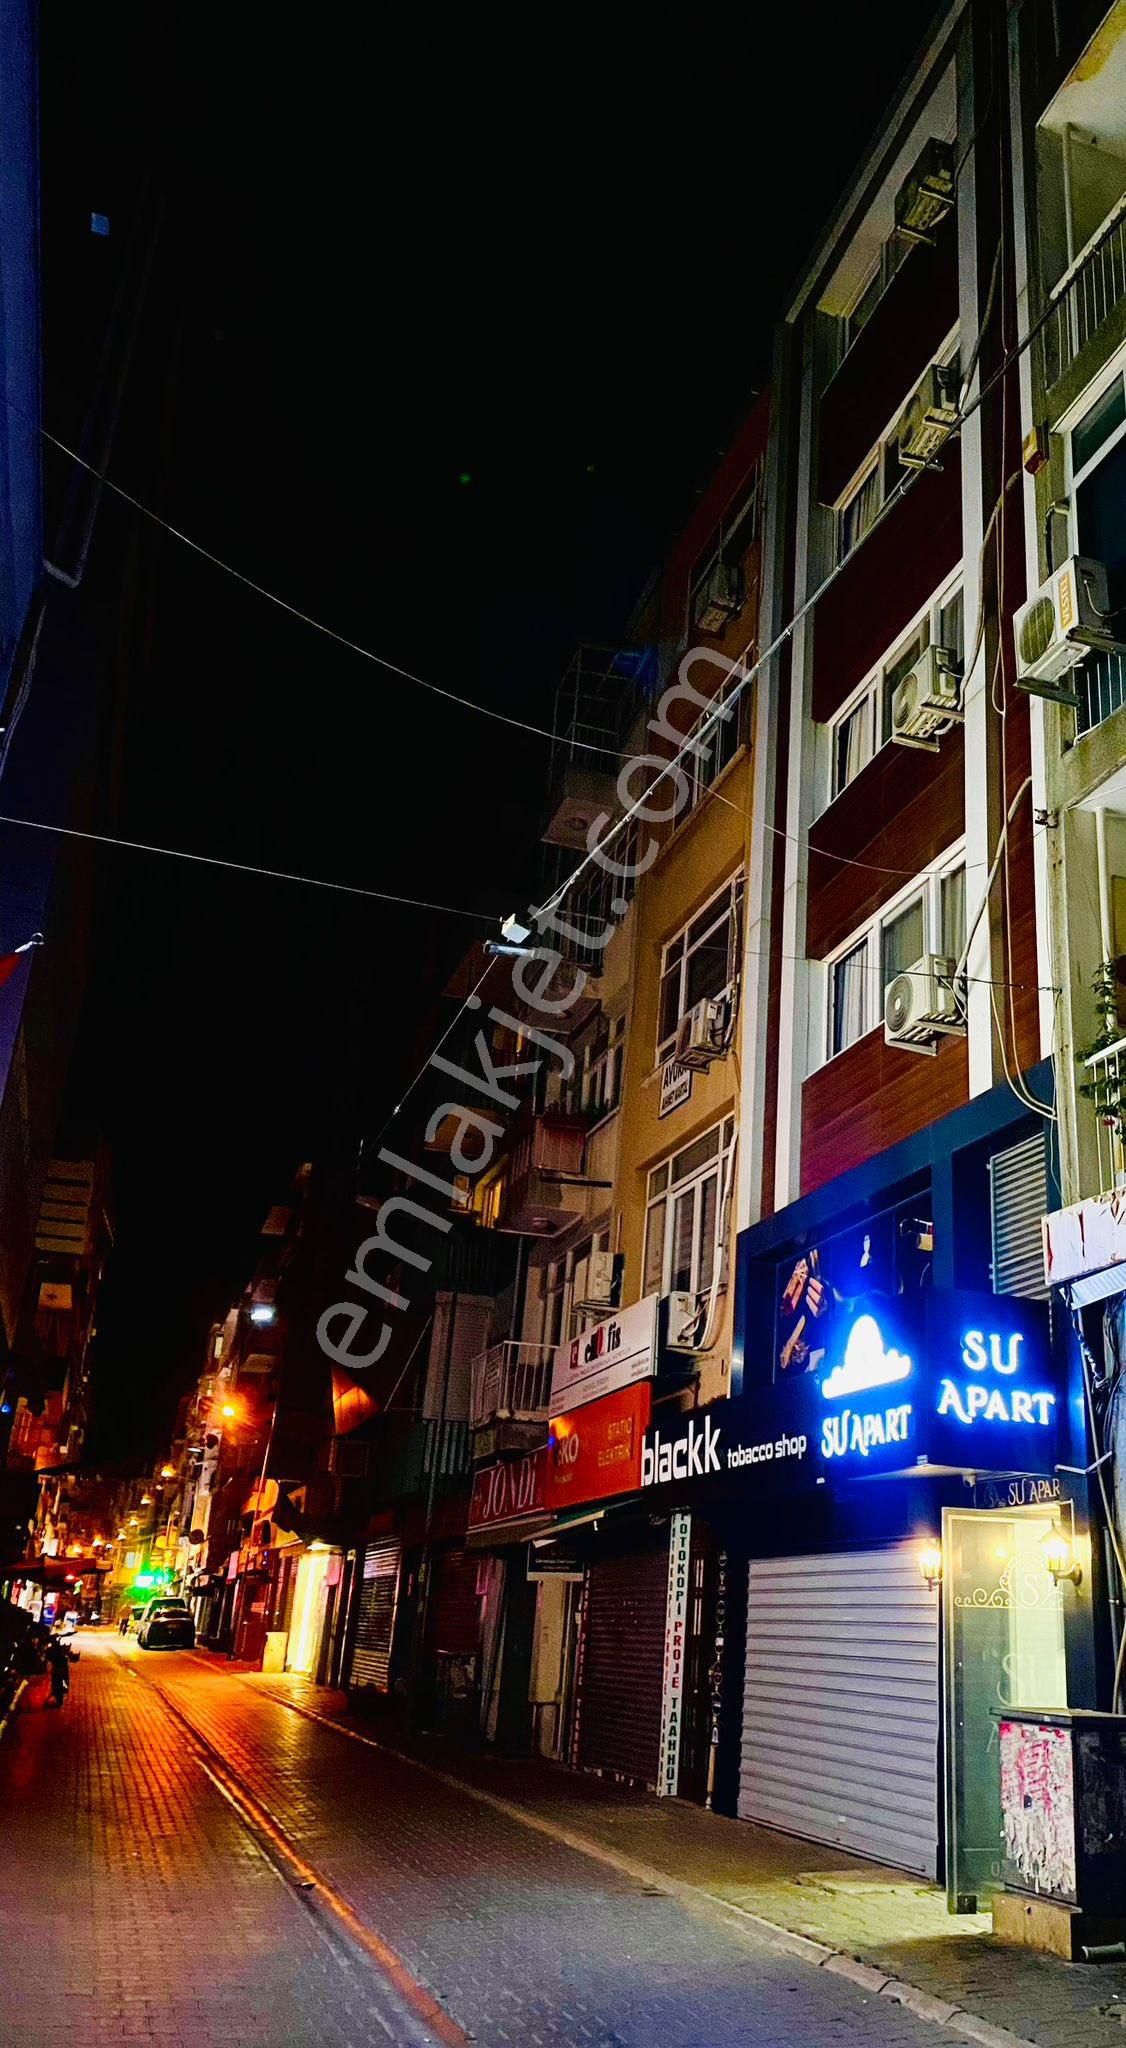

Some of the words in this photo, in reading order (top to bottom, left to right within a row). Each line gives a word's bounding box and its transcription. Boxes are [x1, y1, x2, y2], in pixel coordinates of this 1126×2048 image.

[961, 1330, 1025, 1375] SU
[937, 1378, 1056, 1426] APART
[640, 1414, 721, 1487] blackk
[727, 1441, 773, 1469] tobacco
[775, 1433, 807, 1460] shop
[821, 1410, 850, 1458] SU
[850, 1404, 912, 1456] APART
[1008, 1478, 1027, 1506] SU
[1029, 1478, 1061, 1504] APAR
[671, 1621, 683, 1689] PROJE
